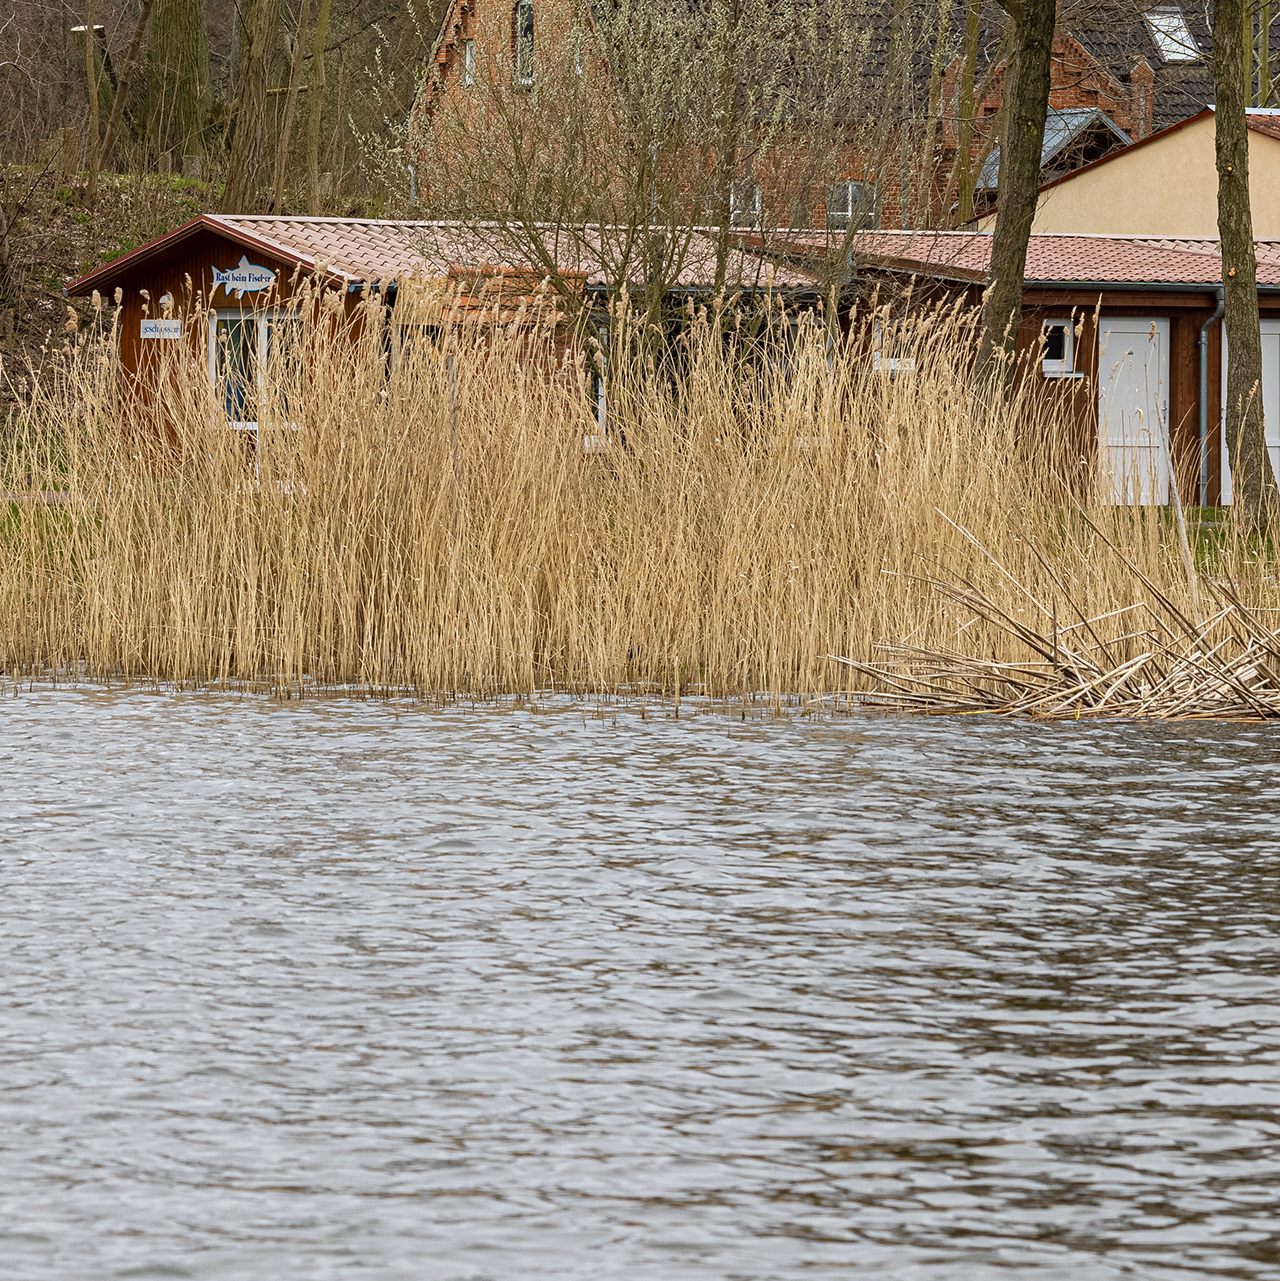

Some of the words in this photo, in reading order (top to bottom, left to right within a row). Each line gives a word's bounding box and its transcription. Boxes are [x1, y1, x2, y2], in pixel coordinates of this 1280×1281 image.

[216, 272, 230, 282] Rast
[232, 272, 247, 282] beim
[248, 273, 271, 282] Fischer
